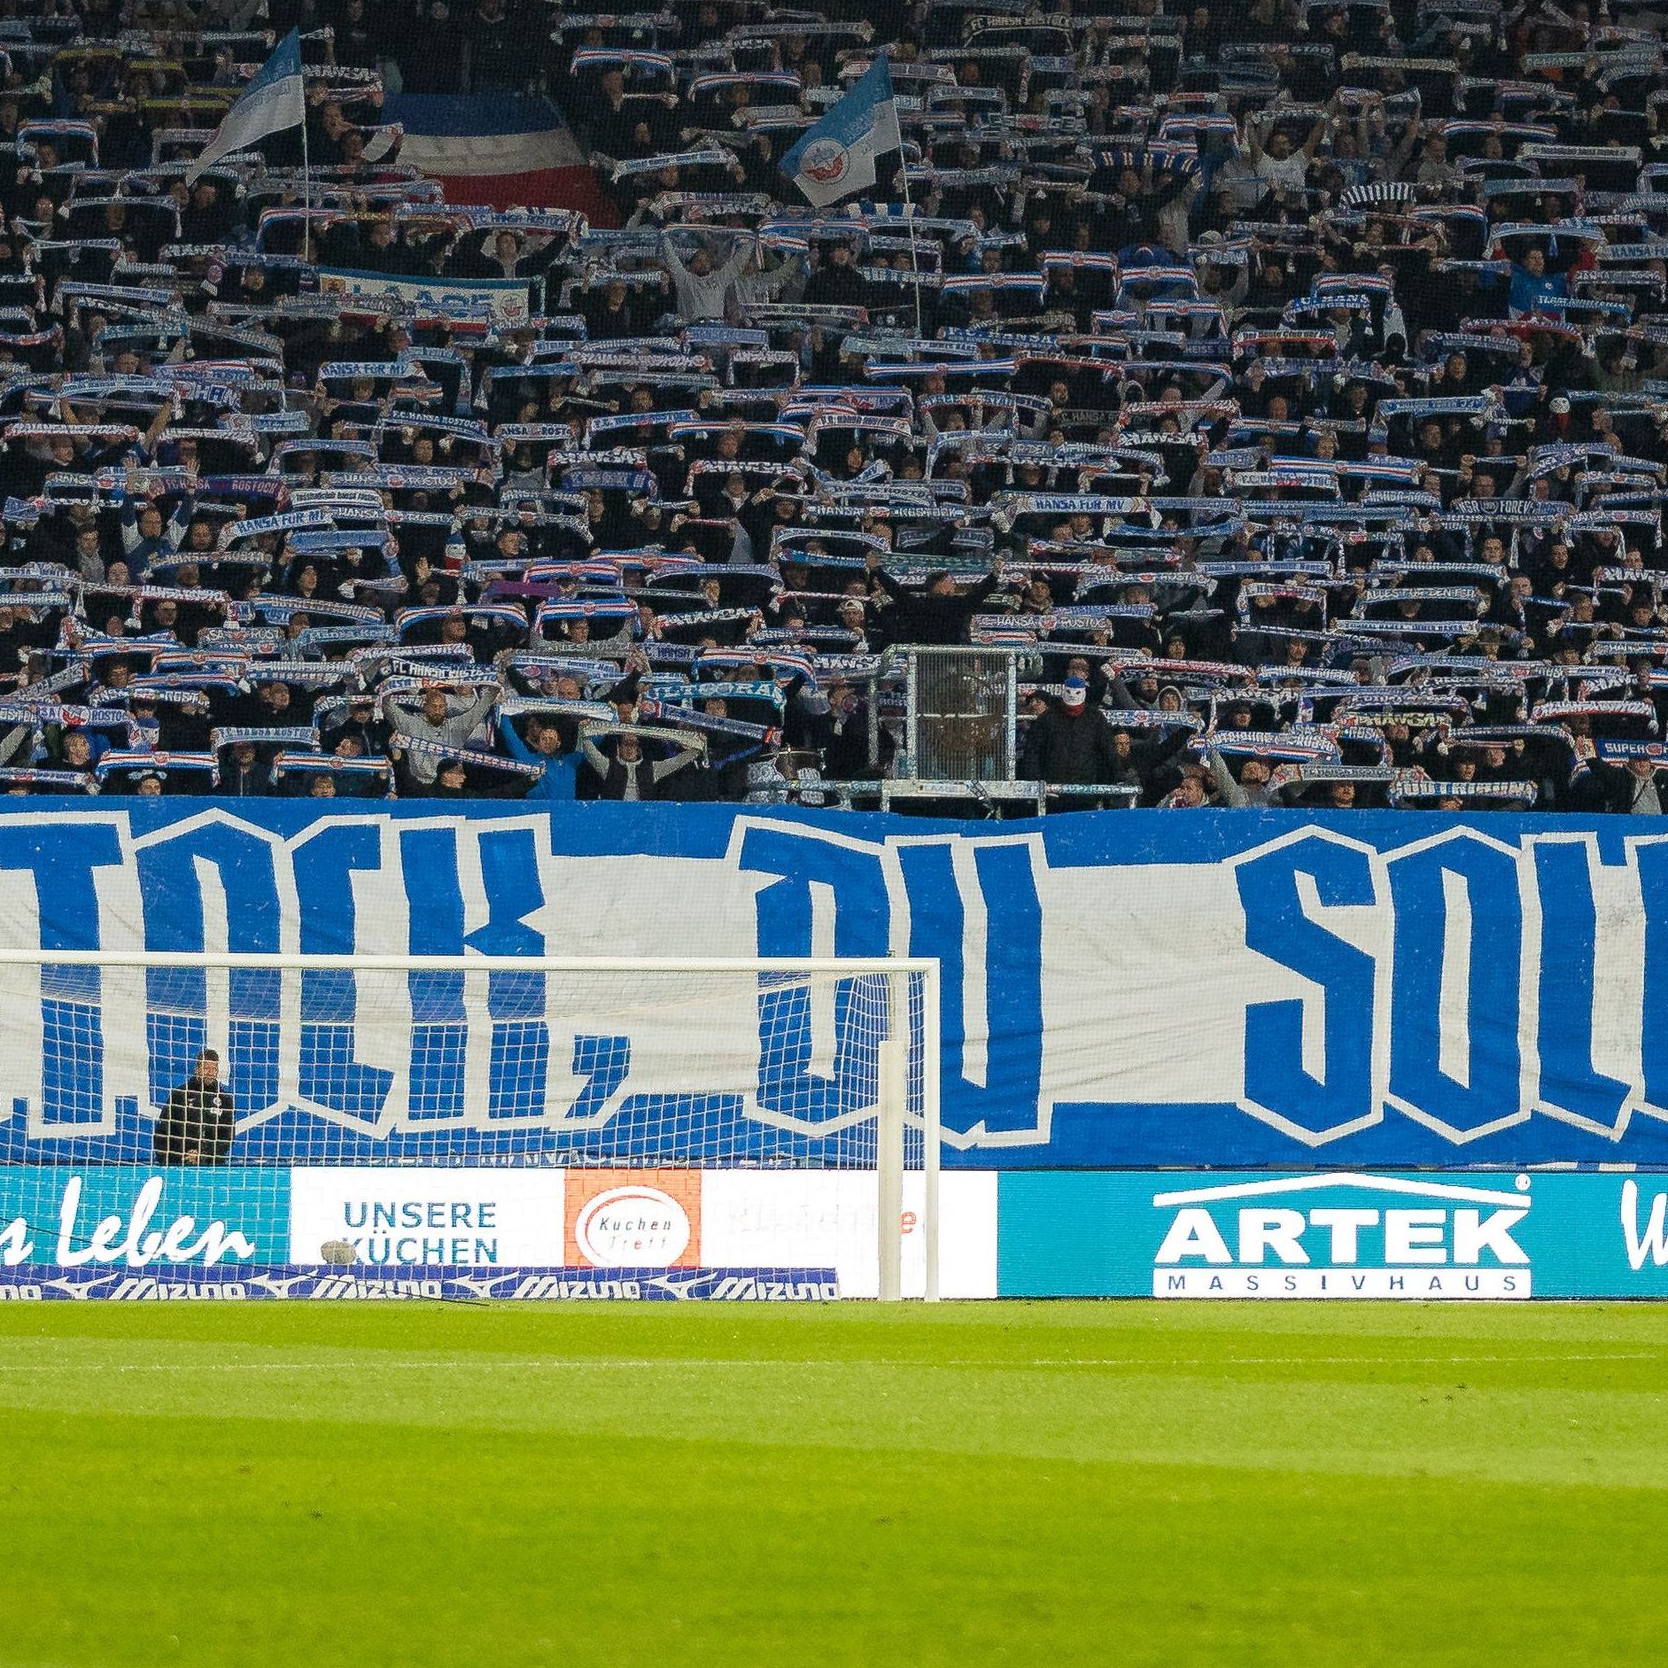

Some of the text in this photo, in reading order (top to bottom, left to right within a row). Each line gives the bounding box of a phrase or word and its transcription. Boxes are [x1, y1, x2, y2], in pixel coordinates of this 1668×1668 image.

[1036, 500, 1075, 511] HANSA
[1604, 743, 1646, 755] SUPER
[740, 818, 1048, 1148] DU
[58, 1176, 255, 1269] Leben
[344, 1201, 498, 1229] UNSERE
[1155, 1207, 1531, 1264] ARTEK
[1167, 1274, 1519, 1292] MASSIVHAUS
